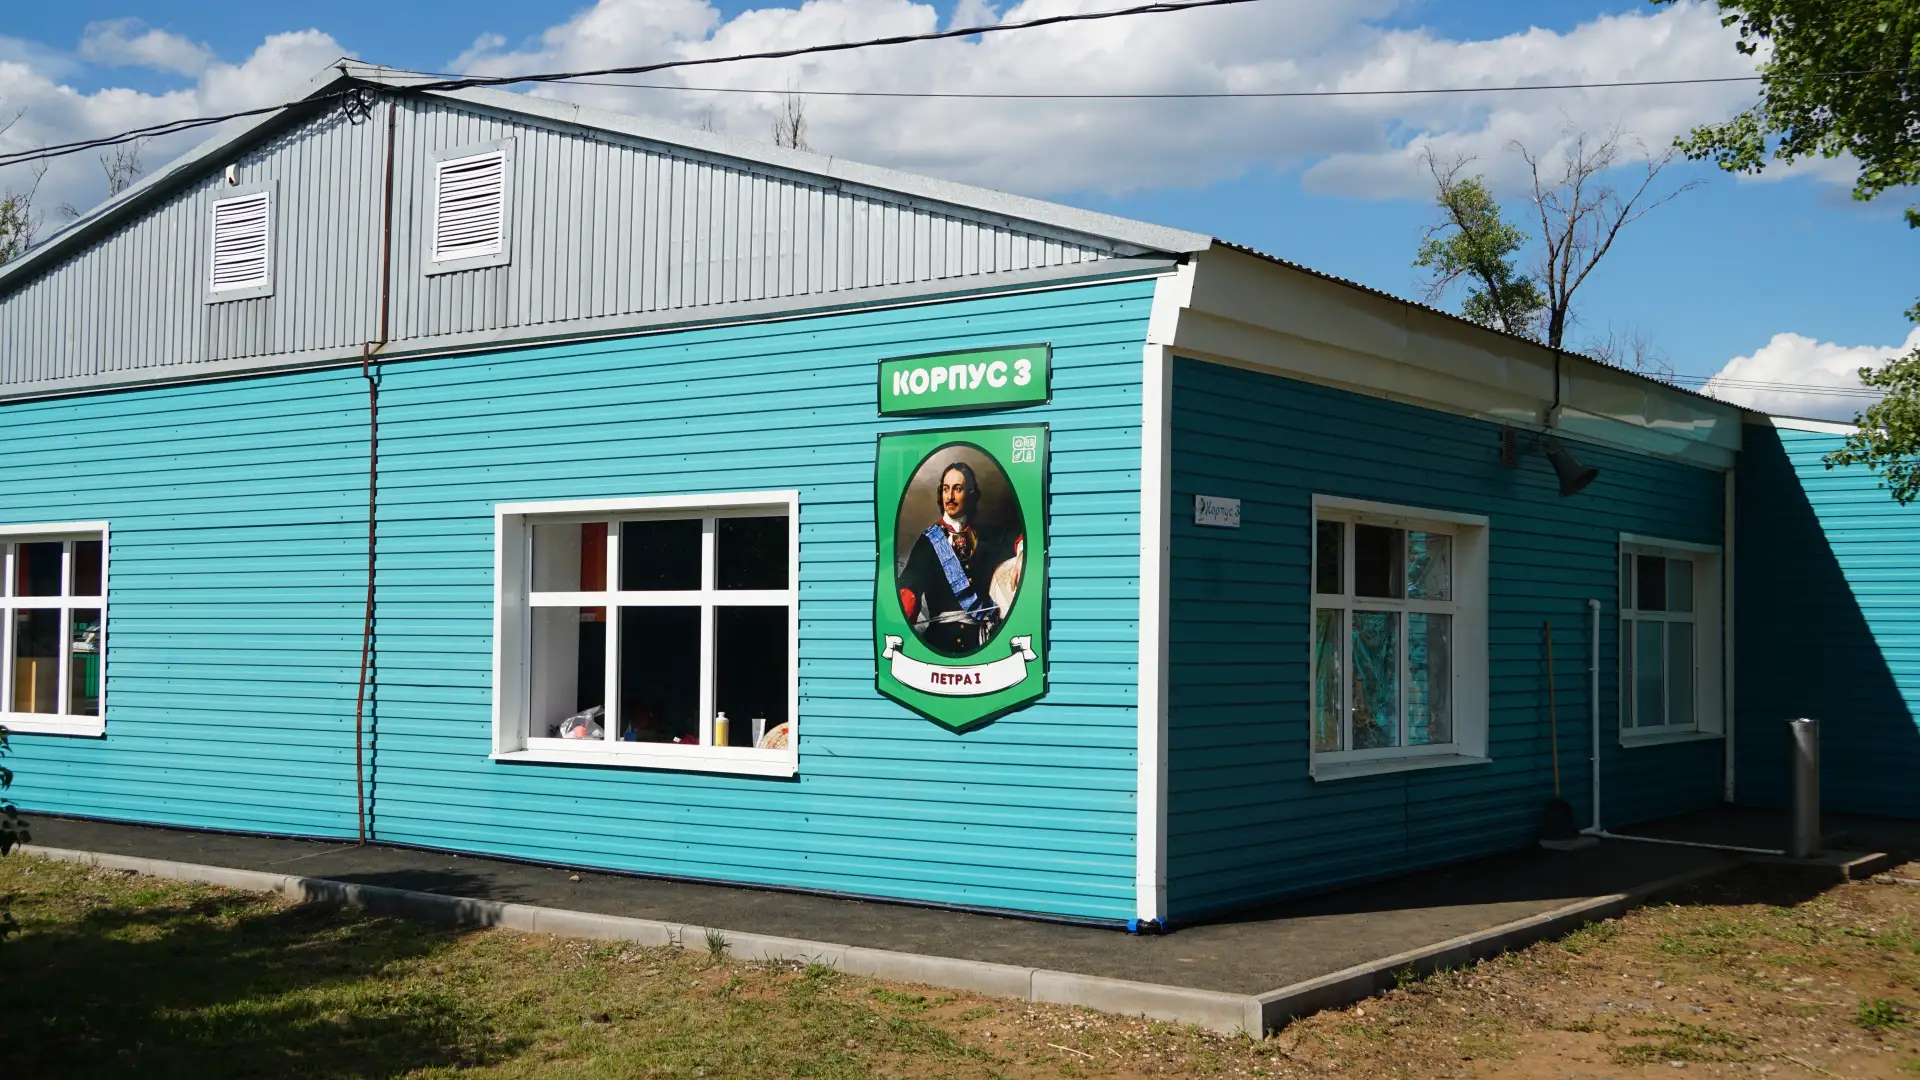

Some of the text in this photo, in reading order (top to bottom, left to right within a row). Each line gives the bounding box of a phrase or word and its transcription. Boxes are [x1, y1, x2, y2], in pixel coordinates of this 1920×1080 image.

[893, 359, 1032, 396] КОРПУС 3
[930, 672, 982, 685] ПЕТРА I
